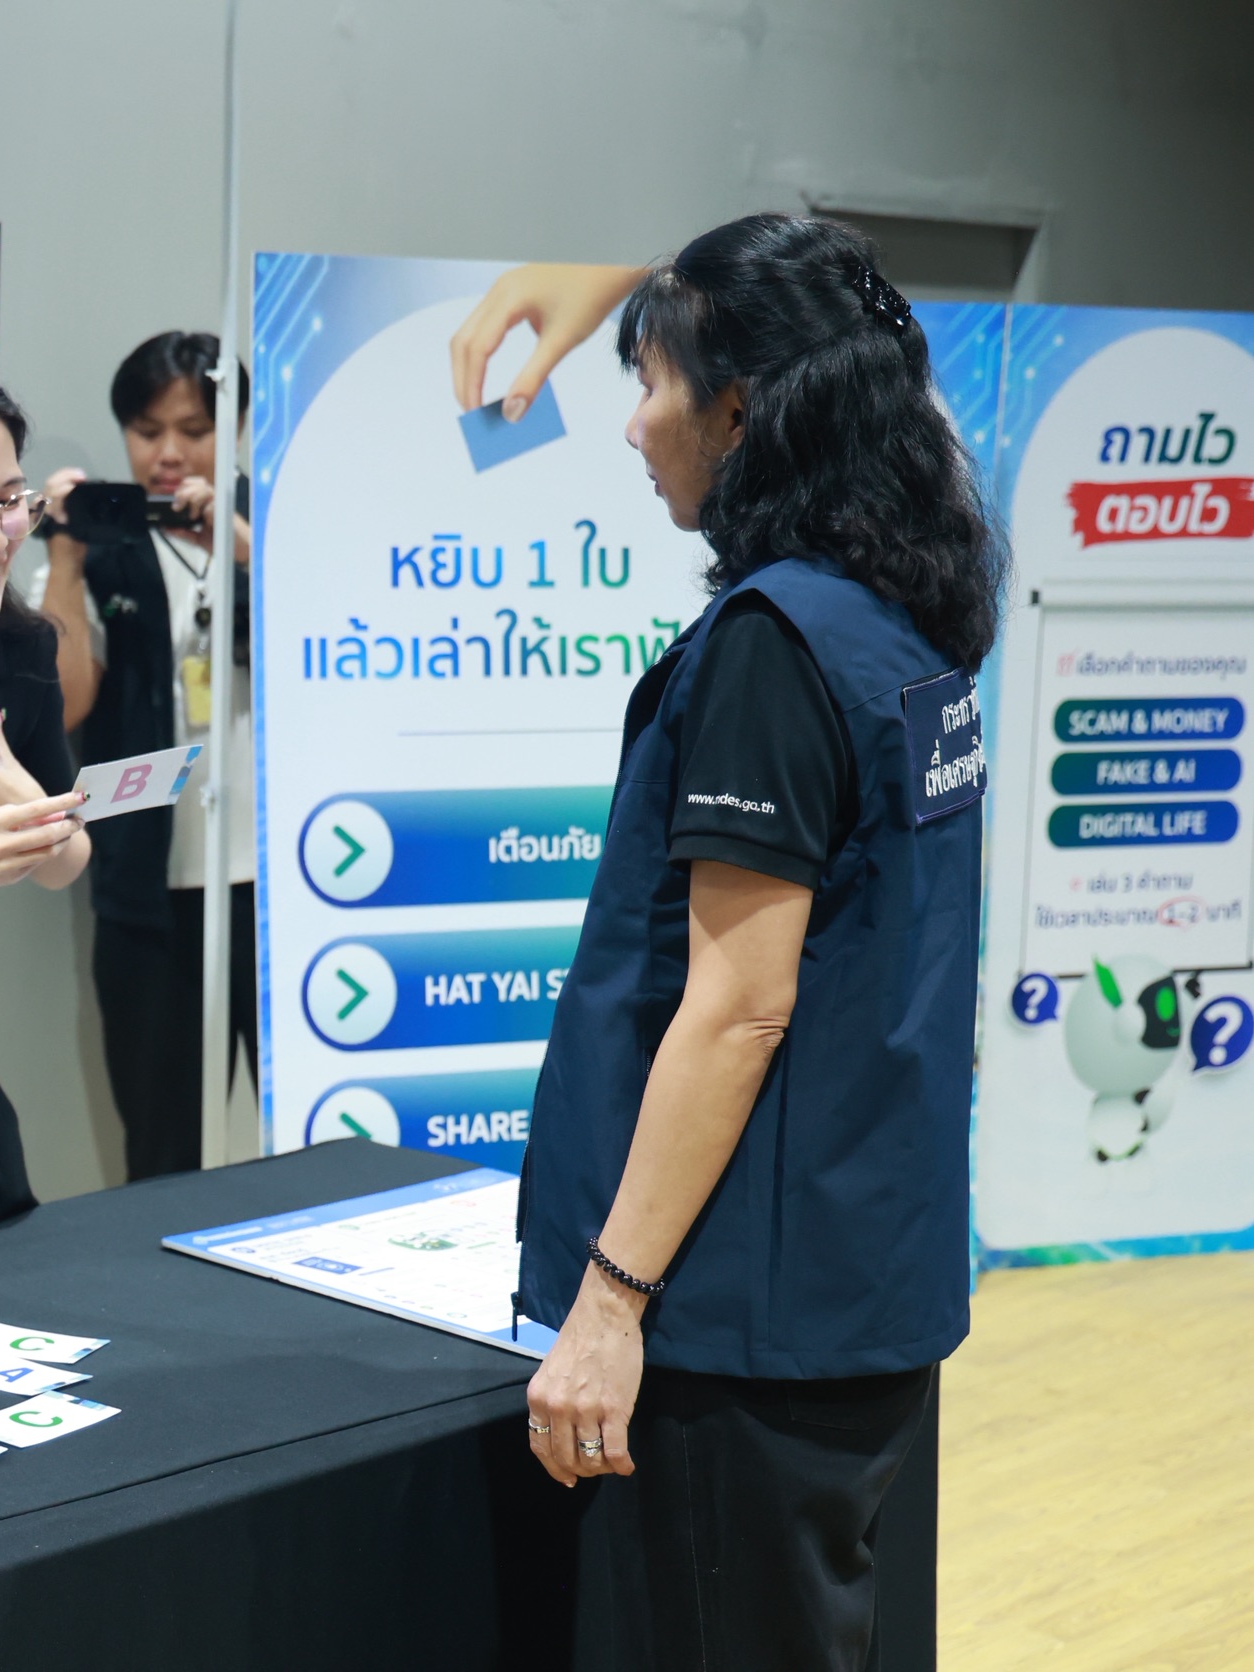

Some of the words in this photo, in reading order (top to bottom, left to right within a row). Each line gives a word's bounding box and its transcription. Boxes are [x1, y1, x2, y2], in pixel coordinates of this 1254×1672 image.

[1099, 412, 1236, 466] ถามไว
[1096, 482, 1231, 534] ตอบไว
[389, 532, 505, 590] หยิบ
[528, 539, 556, 588] 1
[574, 518, 631, 589] ใบ
[302, 607, 680, 681] แล้วเล่าให้เราฟั
[1069, 710, 1129, 736] SCAM
[1131, 710, 1149, 734] &
[1151, 708, 1229, 734] MONEY
[111, 764, 152, 803] B
[1096, 760, 1150, 785] FAKE
[1153, 760, 1170, 784] &
[1172, 760, 1196, 783] AI
[1079, 813, 1159, 839] DIGITAL
[1162, 810, 1207, 836] LIFE
[425, 973, 487, 1006] HAT
[491, 971, 540, 1002] YAI
[546, 968, 570, 1001] S
[427, 1109, 530, 1147] SHARE
[9, 1336, 55, 1350] C
[8, 1410, 63, 1428] C
